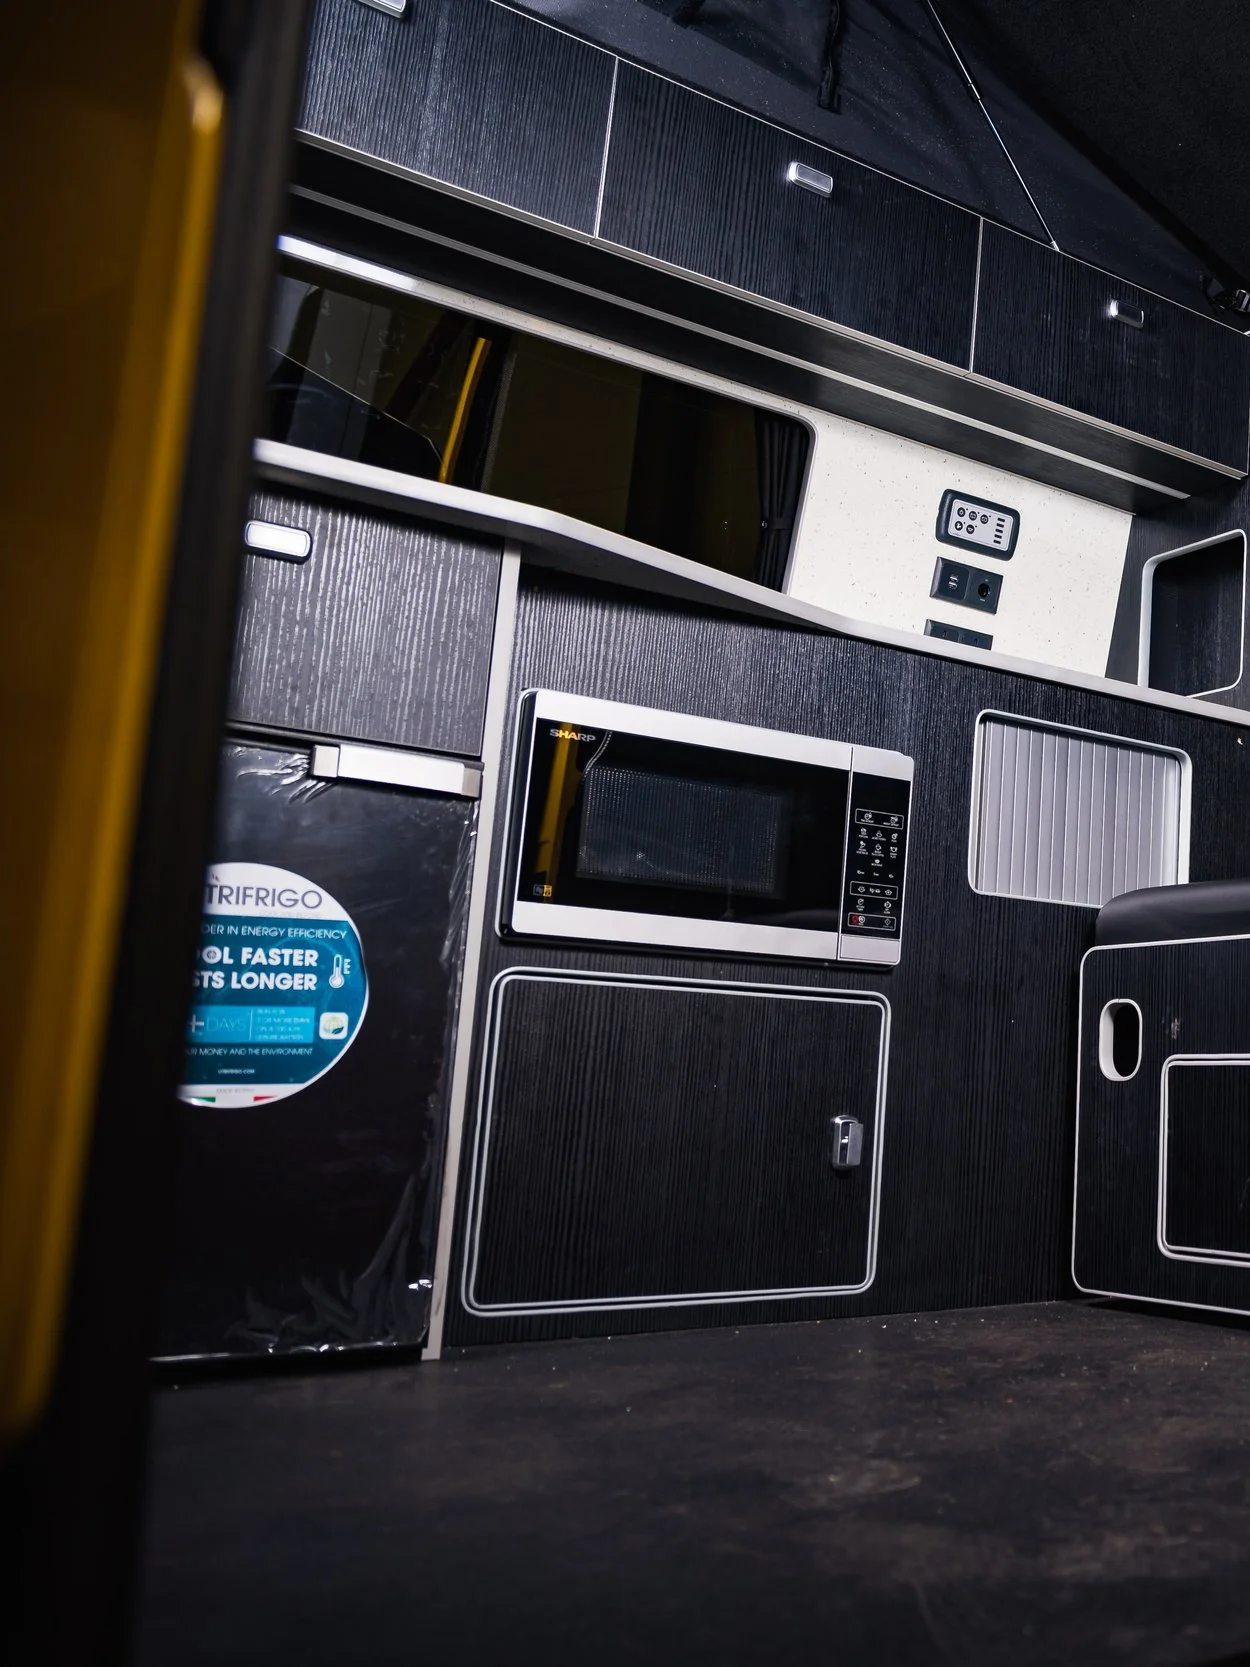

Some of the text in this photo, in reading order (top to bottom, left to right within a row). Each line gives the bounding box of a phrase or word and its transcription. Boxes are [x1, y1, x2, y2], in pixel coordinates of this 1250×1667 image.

[549, 729, 595, 742] SHARP
[227, 924, 239, 936] IN
[241, 925, 285, 937] ENERGY
[288, 927, 348, 940] EFFICIENCY
[196, 945, 319, 967] OL FASTER
[231, 971, 318, 990] LONGER
[199, 1047, 228, 1056] MONEY
[229, 1047, 246, 1056] AND
[248, 1047, 260, 1056] THE
[261, 1047, 313, 1057] ENVIRONMENT
